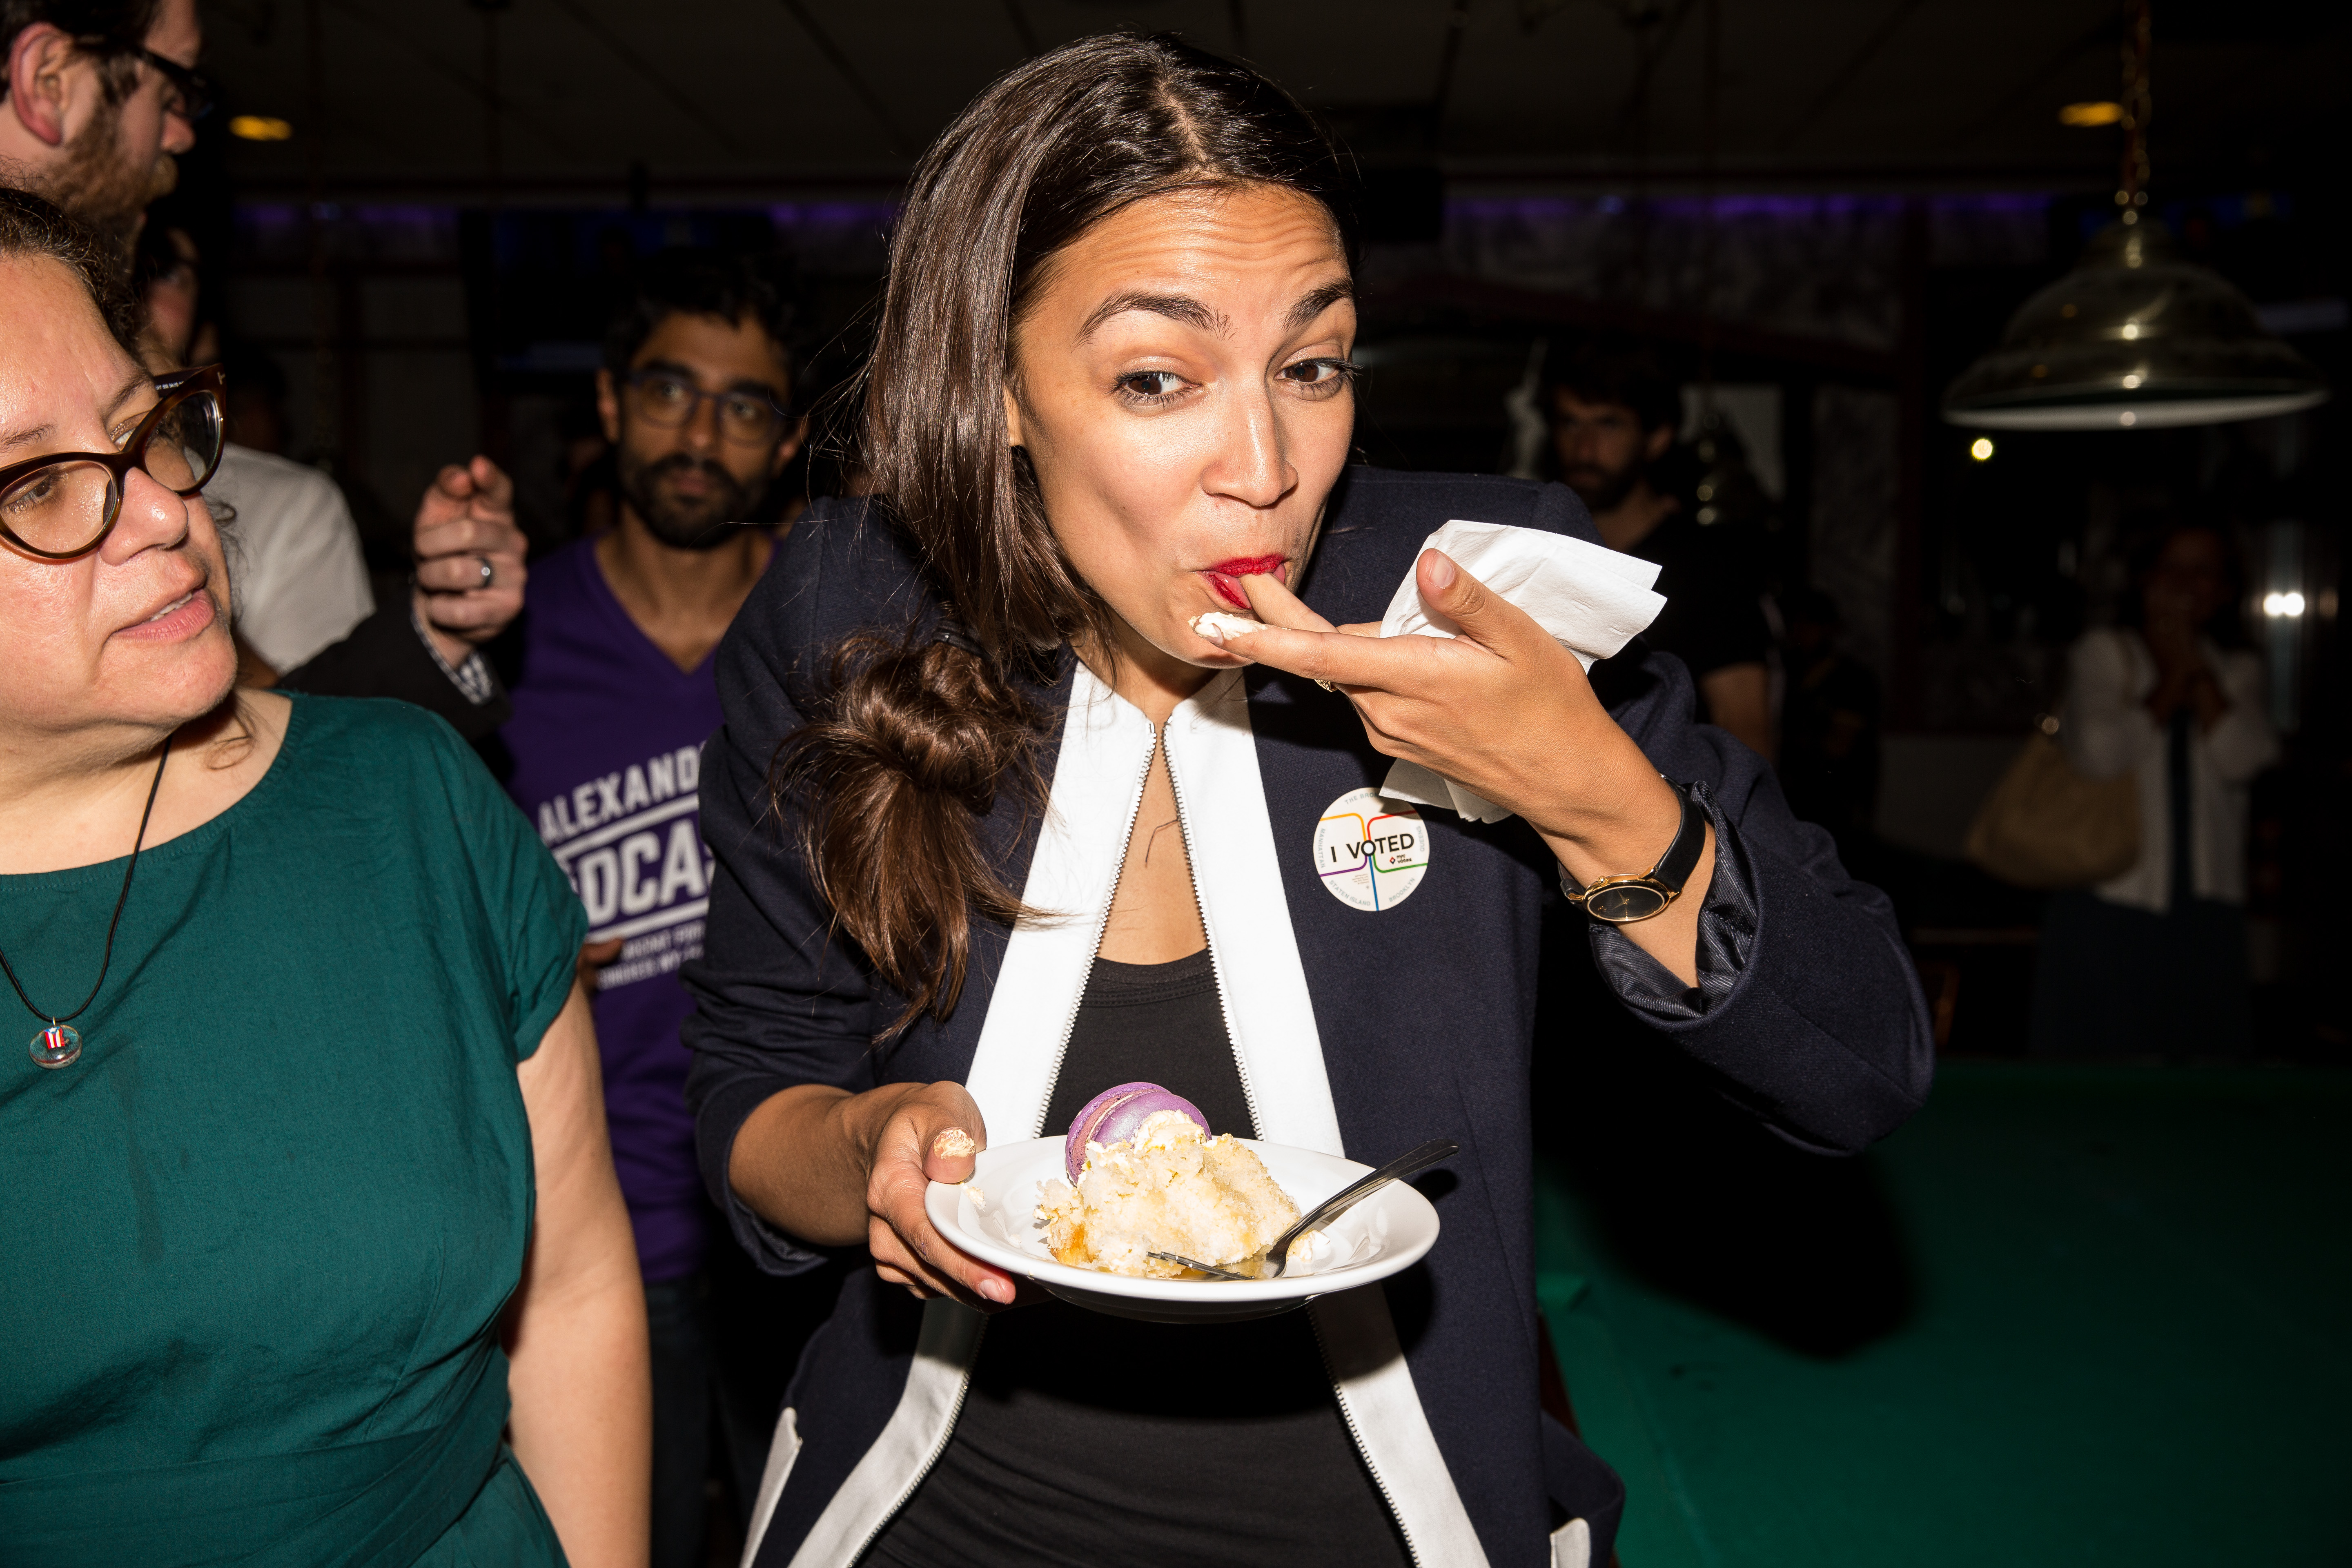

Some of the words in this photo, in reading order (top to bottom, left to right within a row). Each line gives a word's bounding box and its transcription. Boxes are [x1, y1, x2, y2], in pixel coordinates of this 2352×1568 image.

[538, 740, 706, 846] ALEXAND
[1345, 795, 1358, 804] THE
[1331, 846, 1337, 862] I
[1346, 833, 1414, 859] VOTED
[576, 818, 716, 927] OCA
[1330, 880, 1349, 899] STATEN
[1350, 896, 1371, 906] ISLAND
[1389, 878, 1415, 902] BROOKLYN
